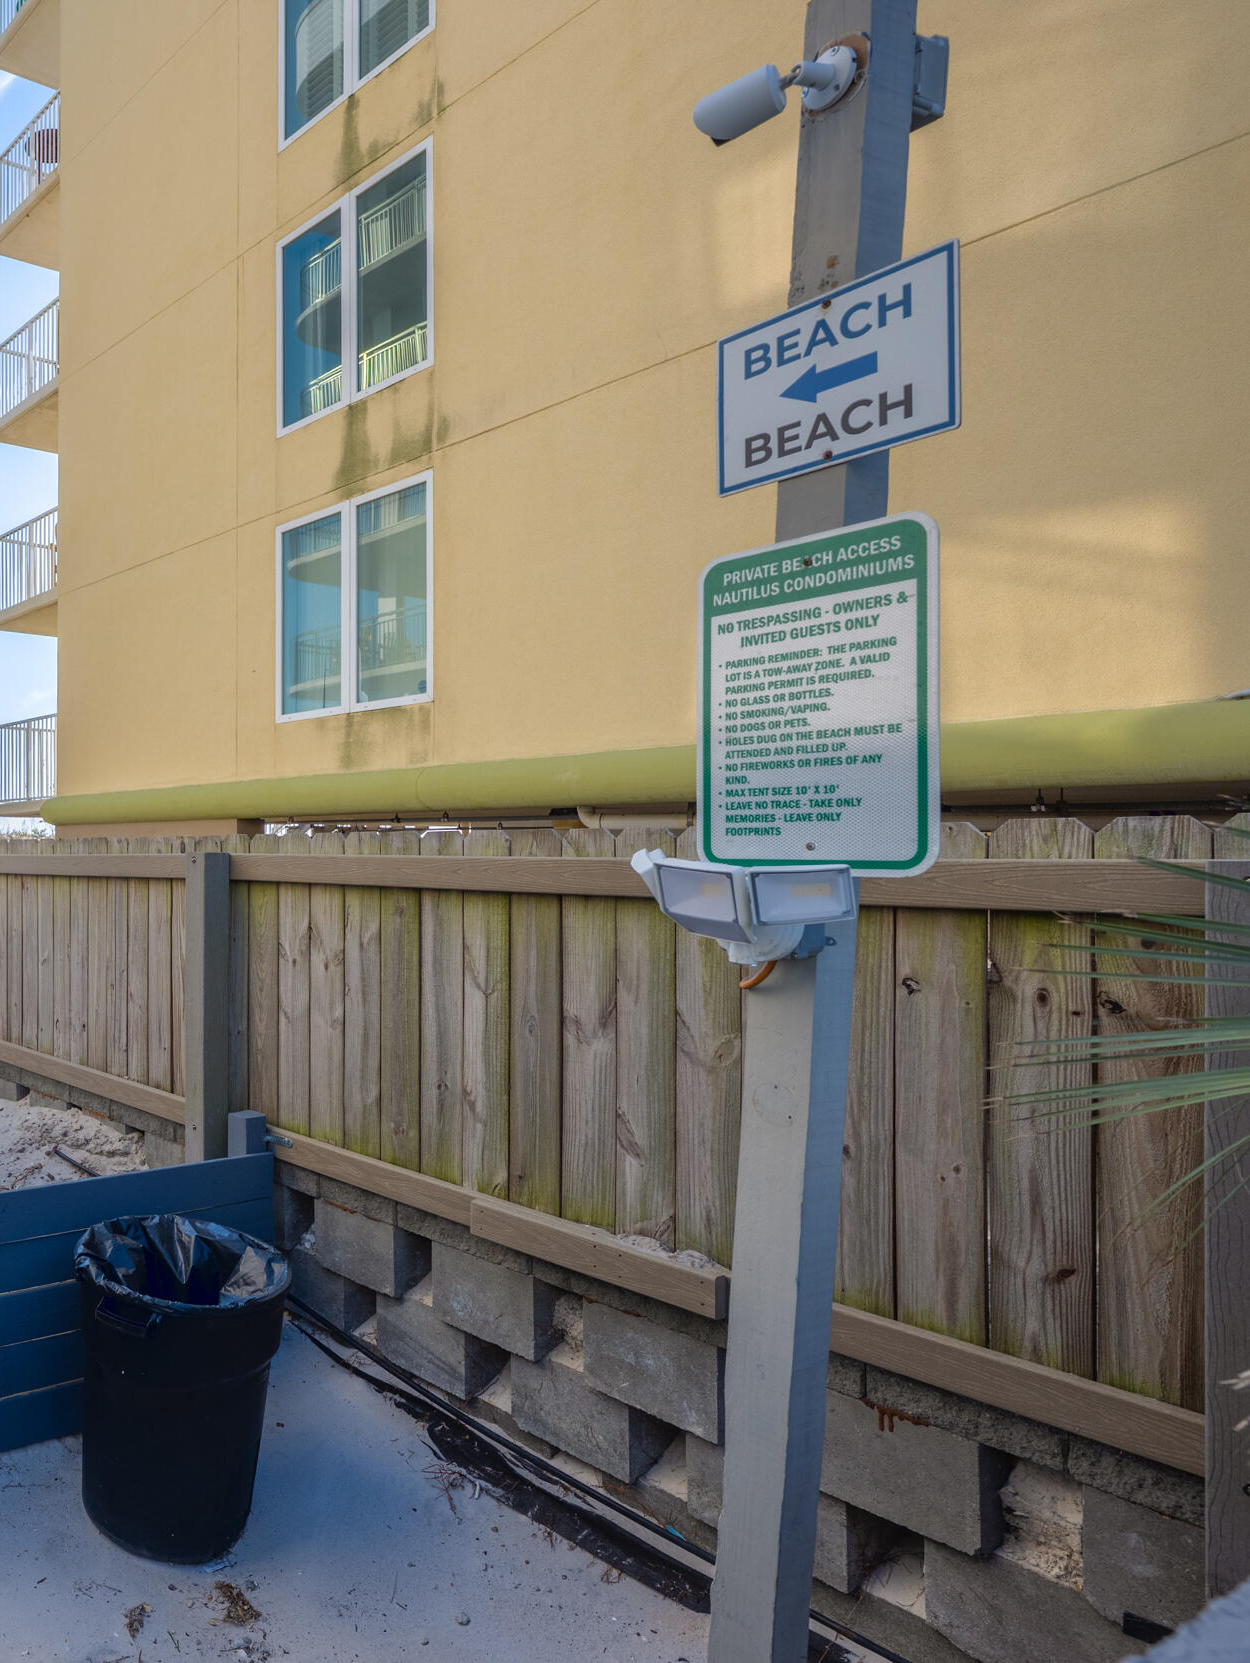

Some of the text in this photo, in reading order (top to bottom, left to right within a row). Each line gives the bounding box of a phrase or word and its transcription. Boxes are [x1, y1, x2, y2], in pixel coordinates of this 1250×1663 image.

[744, 282, 912, 380] BEACH
[745, 383, 913, 469] BEACH
[723, 563, 778, 586] PRIVATE
[836, 535, 901, 561] ACCESS
[713, 554, 914, 607] NAUTILUS CONDOMINIUMS
[718, 623, 734, 635] NO
[736, 607, 822, 631] TRESPASSING
[833, 594, 892, 615] OWNERS
[896, 591, 908, 604] &
[741, 614, 880, 648] INVITED GUESTS ONLY
[726, 637, 897, 669] PARKING REMINDER: THE PARKING
[726, 652, 890, 682] LOT IS A TOW-AWAY ZONE. A VALID
[726, 669, 874, 695] PARKING PERMIT IS REQUIRED.
[726, 688, 834, 708] NO GLASS OR BOTTLES.
[726, 703, 830, 721] NO SMOKING/VAPING.
[726, 718, 810, 733] NO DOGS OR PETS.
[726, 723, 902, 747] HOLES DUG ON THE BEACH MUST BE
[726, 743, 847, 759] ATTENDED AND FILLED UP.
[726, 754, 882, 772] NO FIREWORKS OR FIRES OF ANY
[726, 775, 749, 785] KIND.
[726, 788, 745, 797] MAX
[749, 787, 769, 796] TENT
[772, 787, 792, 796] SIZE
[814, 786, 821, 794] X
[726, 801, 752, 810] LEAVE
[755, 800, 768, 809] NO
[771, 799, 800, 809] TRACE
[809, 799, 834, 808] TAKE
[836, 798, 862, 807] ONLY
[726, 814, 776, 823] MEMORIES
[784, 813, 814, 822] LEAVE
[816, 812, 842, 822] ONLY
[726, 826, 781, 836] FOOTPRINTS
